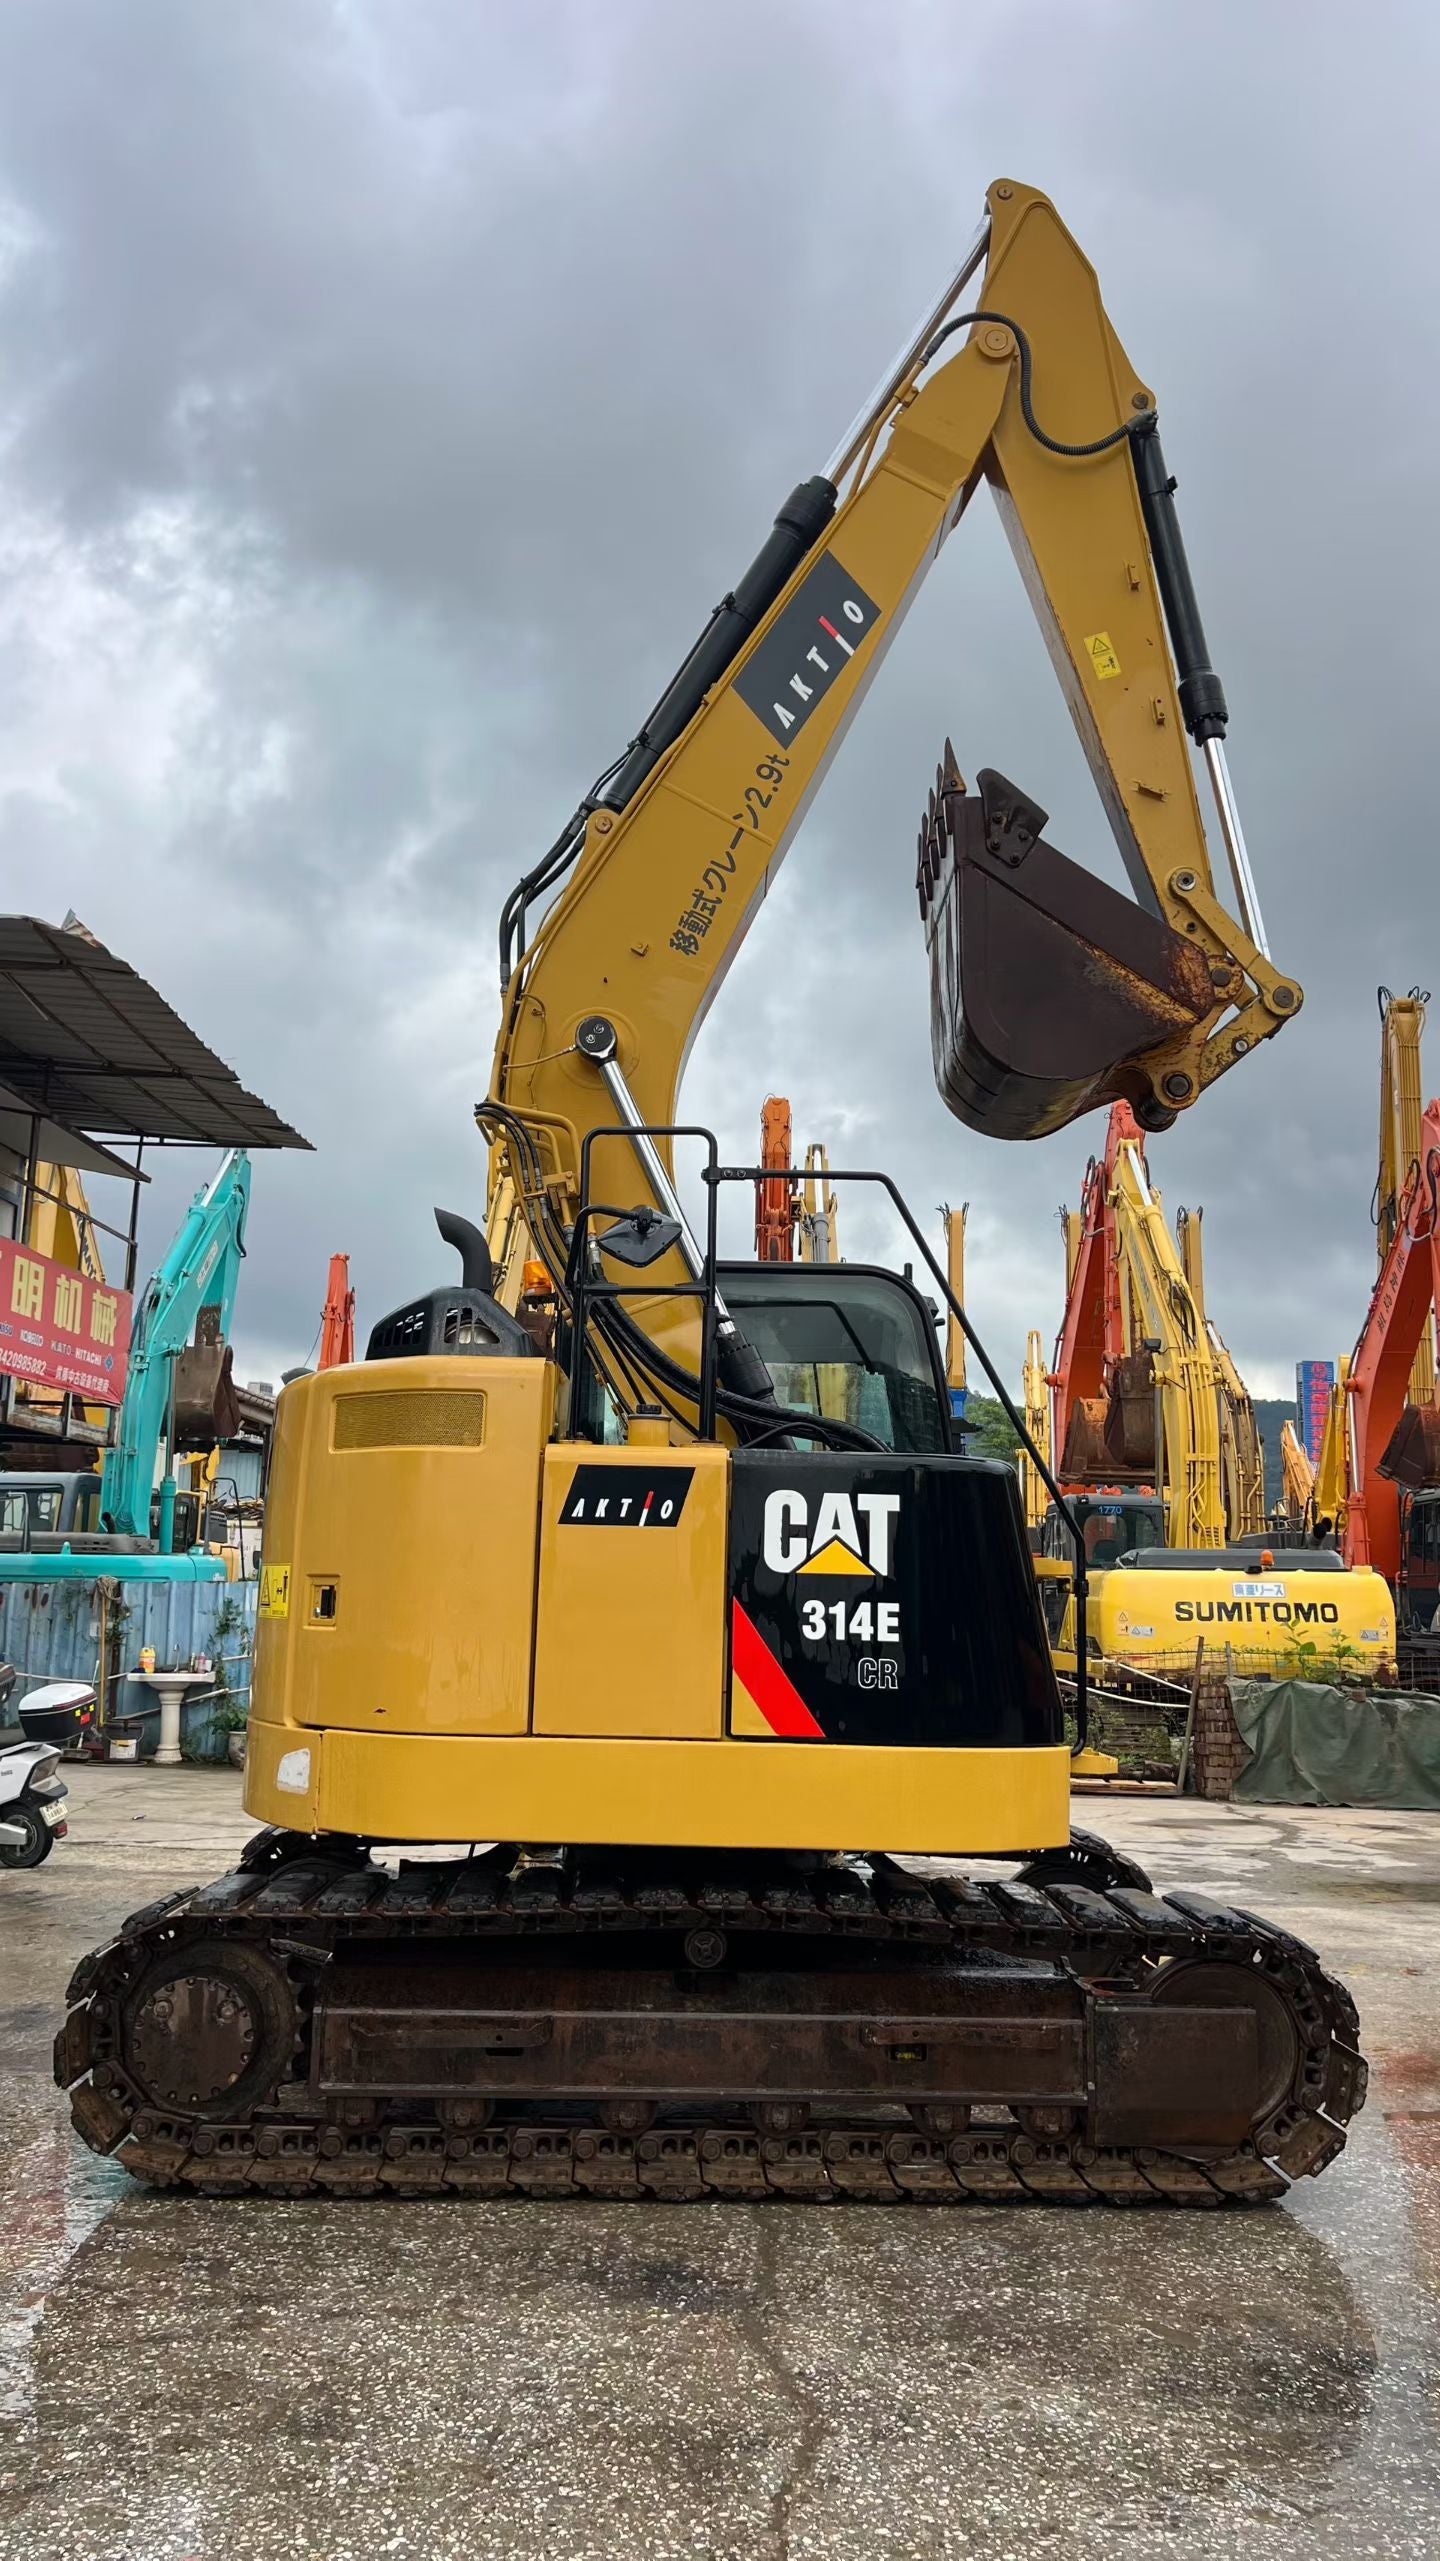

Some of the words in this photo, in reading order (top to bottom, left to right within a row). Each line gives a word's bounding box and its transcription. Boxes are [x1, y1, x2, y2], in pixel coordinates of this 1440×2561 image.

[772, 599, 864, 729] AKTIO
[0, 1252, 119, 1347] 明机械
[74, 1346, 103, 1367] HITACHI
[571, 1490, 675, 1527] AKTIO
[1098, 1505, 1123, 1515] 1770
[763, 1489, 901, 1576] CAT
[802, 1599, 901, 1643] 314E
[1175, 1601, 1339, 1624] SUMITOMO
[857, 1657, 899, 1690] CR
